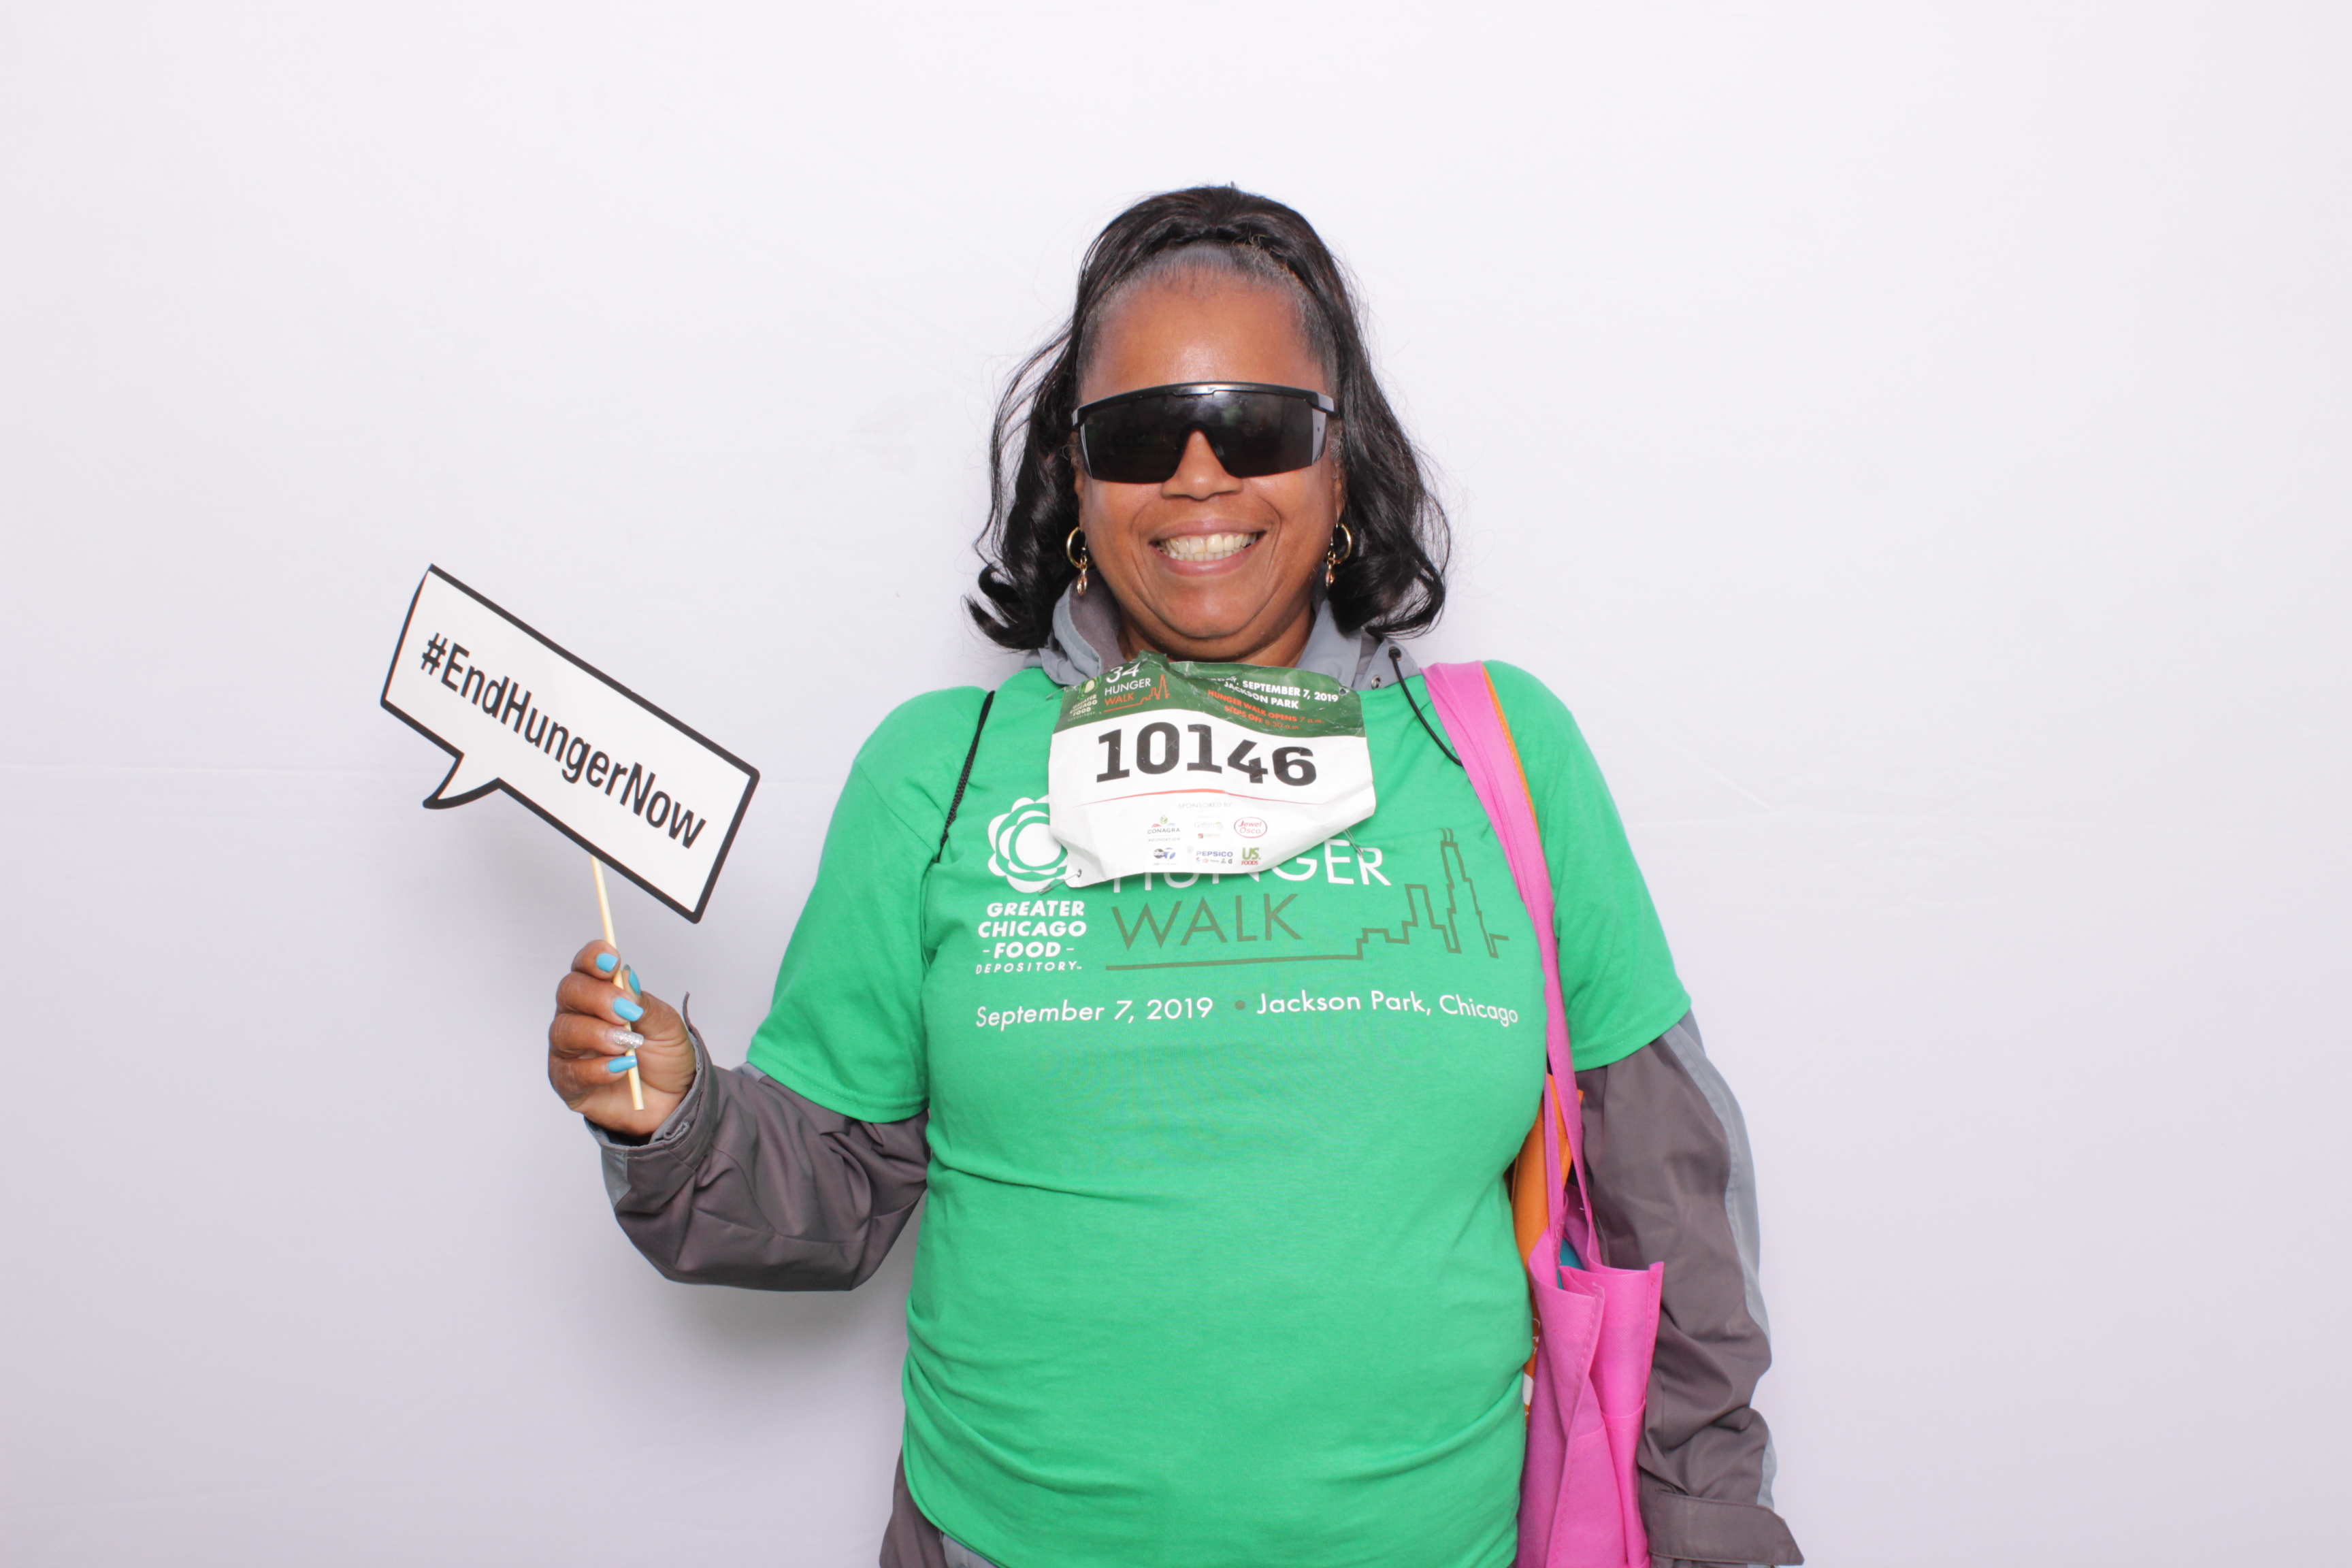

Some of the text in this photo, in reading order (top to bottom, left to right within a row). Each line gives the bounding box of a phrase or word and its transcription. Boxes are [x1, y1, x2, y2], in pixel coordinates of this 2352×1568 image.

[1106, 662, 1141, 683] 34
[1105, 678, 1152, 696] HUNGER
[1224, 681, 1299, 709] JACKSON PARK
[1242, 680, 1301, 697] SEPTEMBER
[1303, 689, 1311, 700] 7,
[1313, 691, 1339, 702] 2019
[1104, 692, 1135, 706] WALK
[1207, 689, 1243, 706] HUNGER
[1243, 702, 1267, 716] WALK
[1268, 713, 1298, 722] OPENS
[1224, 705, 1247, 718] STEPS
[1248, 713, 1263, 723] OFF
[421, 632, 706, 849] #EndHungerNow
[1096, 721, 1317, 786] 10146
[987, 900, 1085, 917] GREATER
[978, 921, 1087, 938] CHICAGO
[1111, 894, 1303, 951] WALK
[976, 990, 1518, 1032] September 7, 2019 Jackson Park, Chicago
